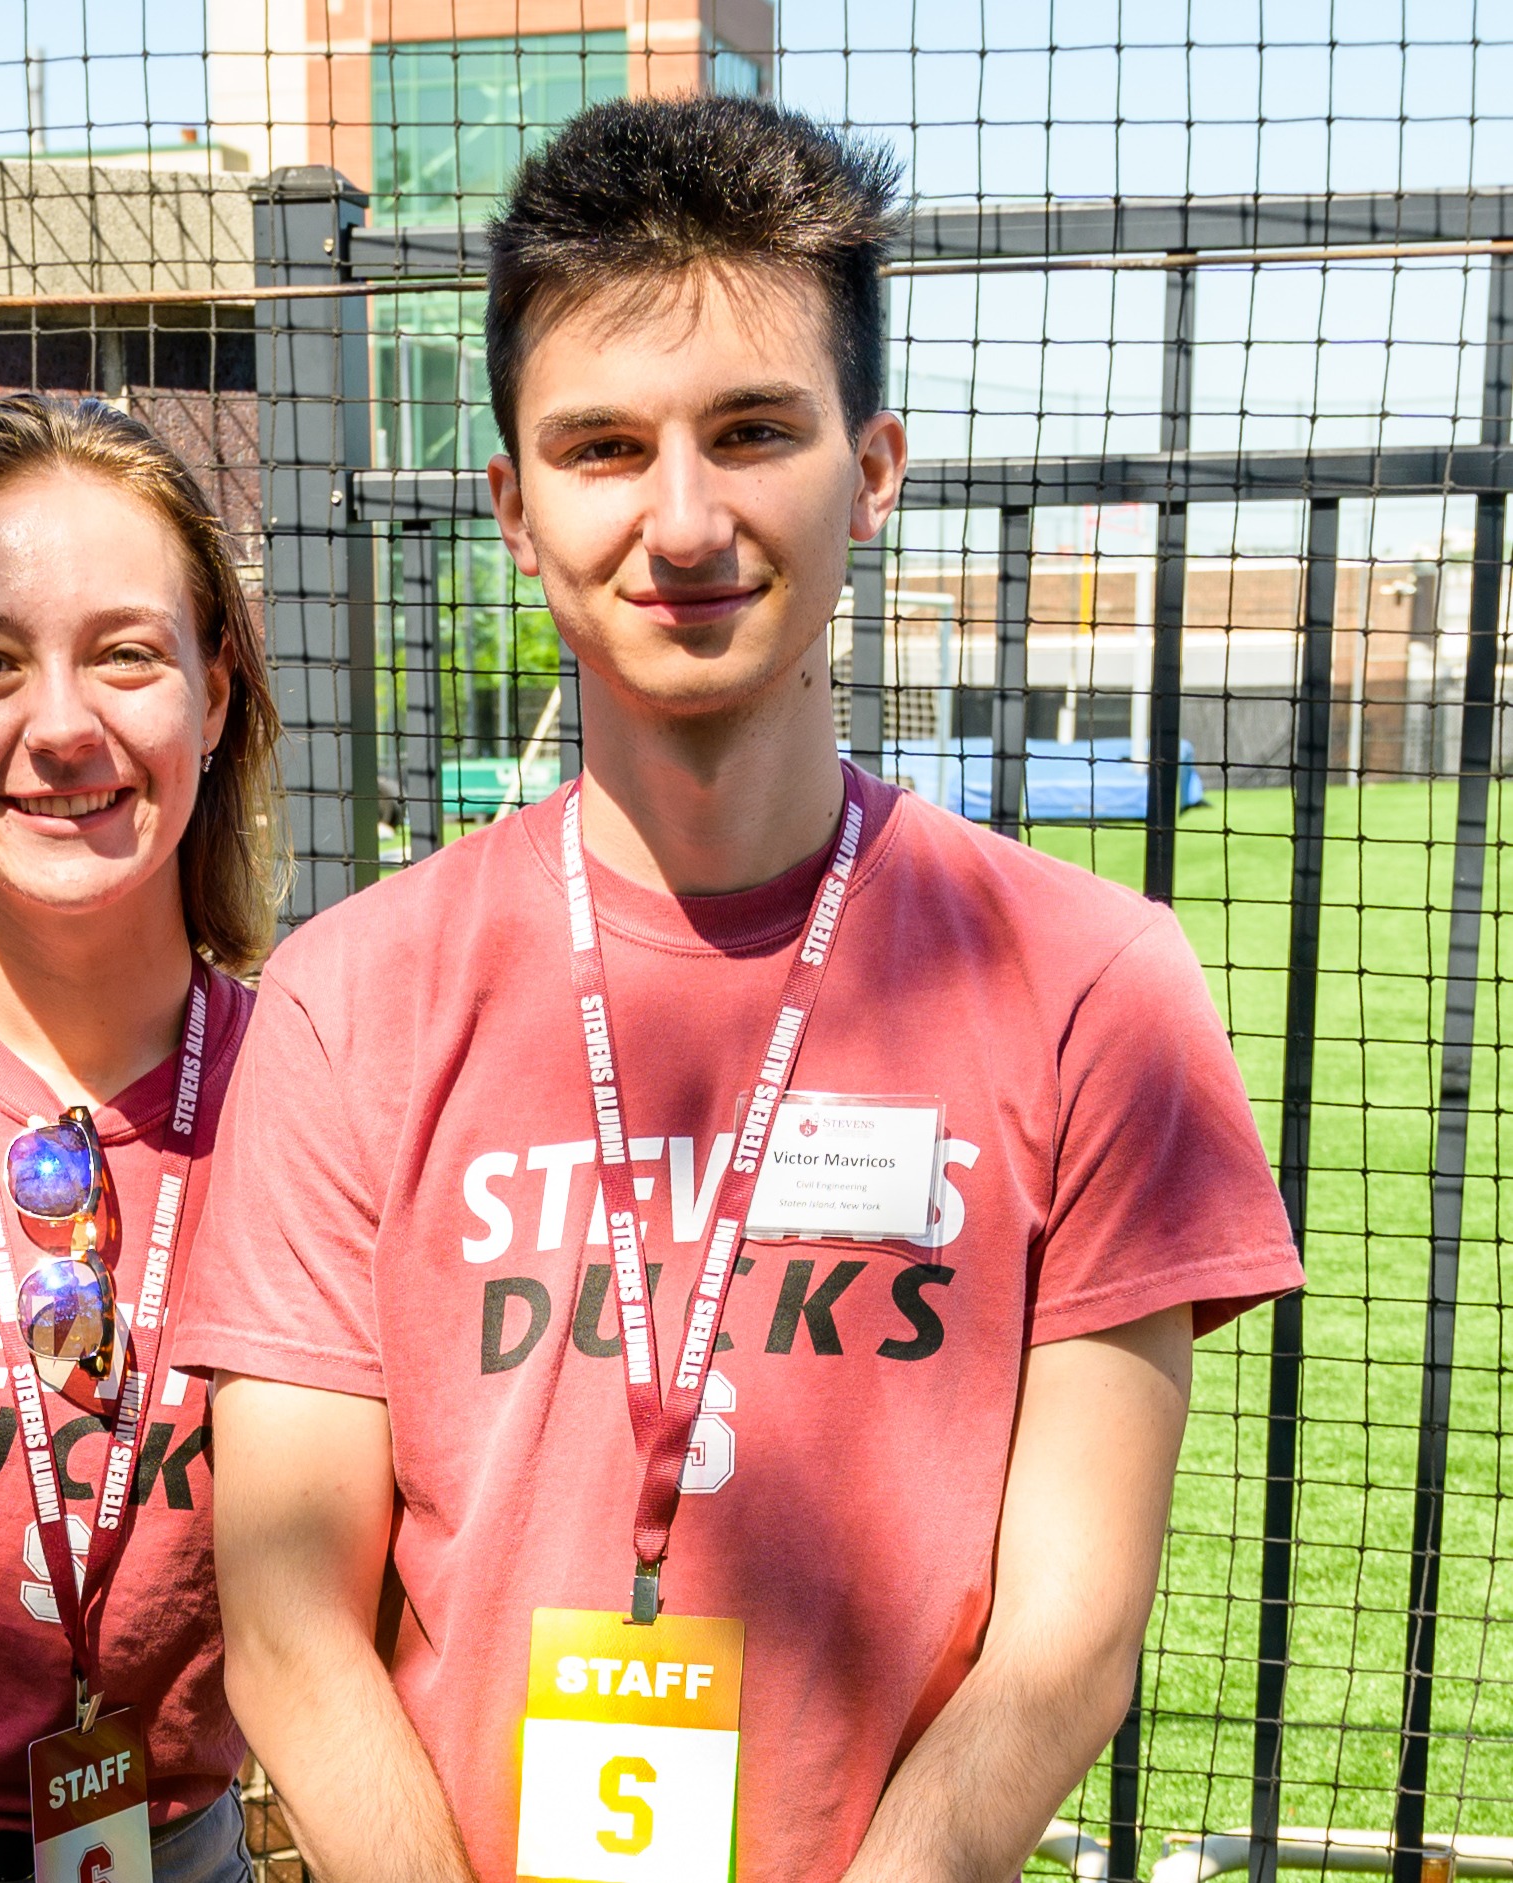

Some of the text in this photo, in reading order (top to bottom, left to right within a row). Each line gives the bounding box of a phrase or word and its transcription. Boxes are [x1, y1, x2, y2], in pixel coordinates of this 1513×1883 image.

[801, 800, 864, 966] STEVENS ALUMNI
[173, 985, 207, 1135] STEVENS ALUMNI
[580, 994, 626, 1165] STEVENS ALUMNI
[733, 1006, 805, 1173] STEVENS ALUMNI
[823, 1117, 876, 1130] STEVENS
[461, 1133, 981, 1264] STEVS
[773, 1150, 897, 1168] Victor Mavricos
[796, 1180, 868, 1193] Civil Engineering
[839, 1201, 859, 1210] New
[861, 1201, 882, 1211] York
[136, 1173, 183, 1329] STEVENS ALUMNI
[609, 1211, 652, 1384] STEVENS ALUMNI
[676, 1218, 740, 1389] STEVENS ALUMNI
[12, 1363, 61, 1524] STEVENS ALUMNI
[97, 1369, 148, 1530] STEVENS ALUMNI
[555, 1655, 715, 1700] STAFF
[48, 1750, 131, 1810] STAFF
[596, 1755, 658, 1857] S
